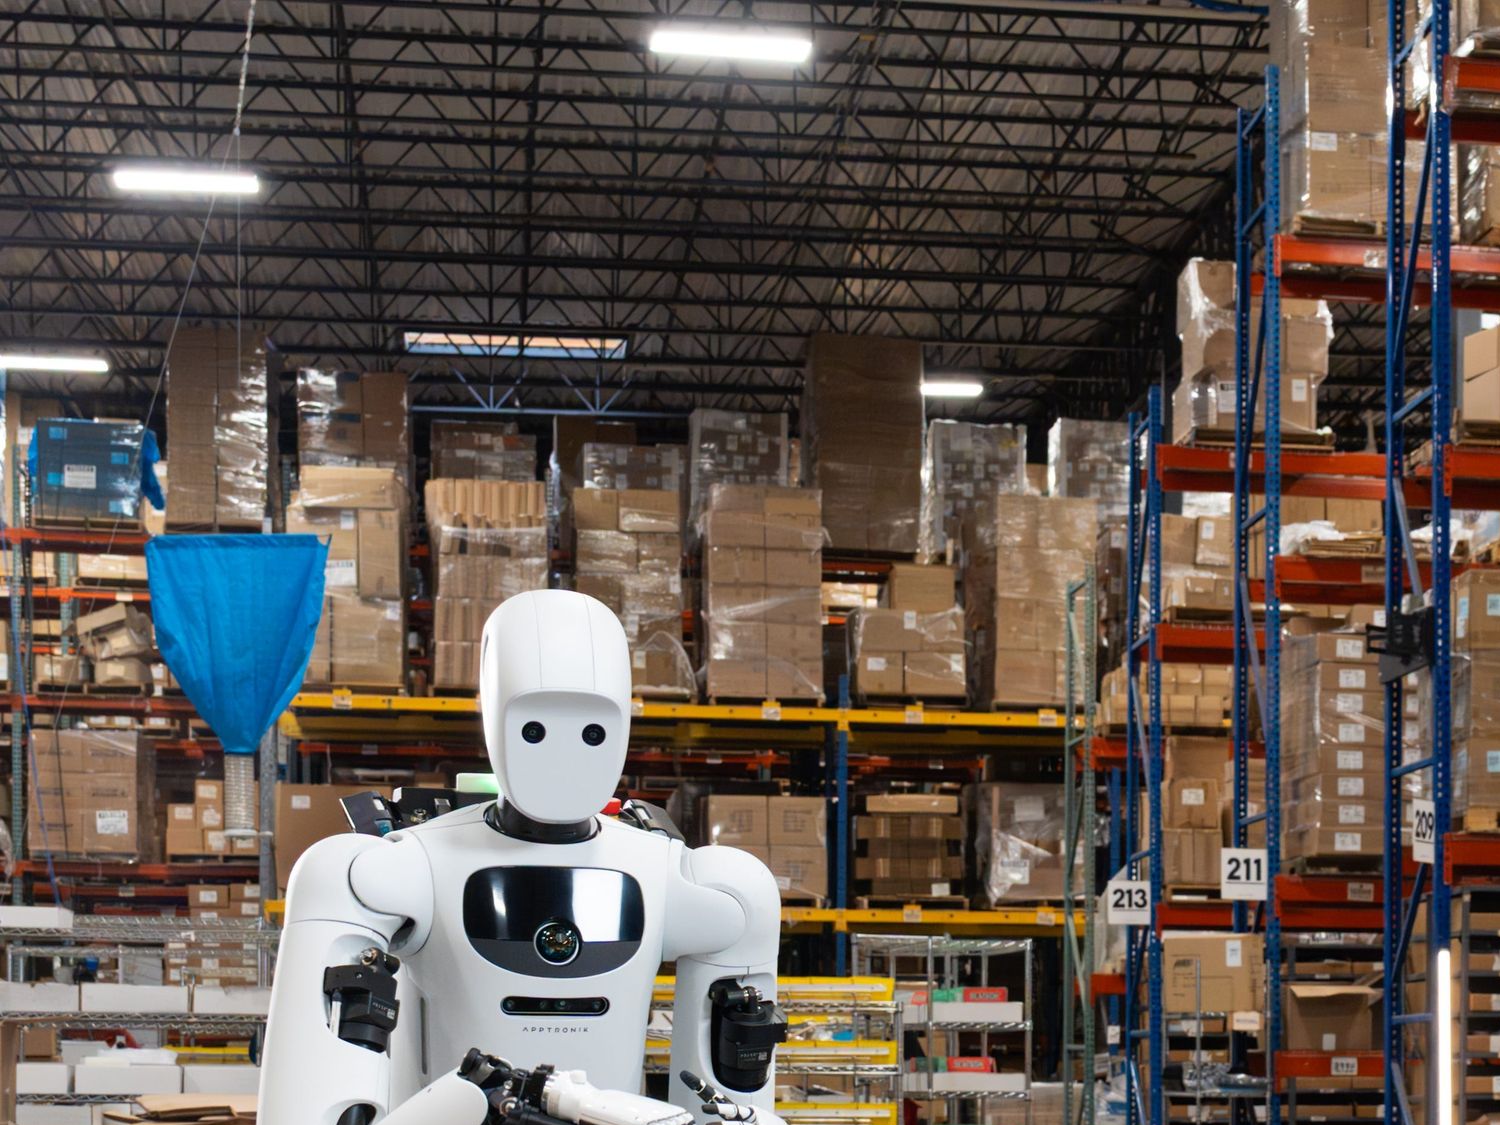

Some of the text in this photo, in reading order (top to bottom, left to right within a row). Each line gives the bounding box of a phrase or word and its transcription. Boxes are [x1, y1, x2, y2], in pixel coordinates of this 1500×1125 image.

[1415, 810, 1434, 840] 209
[1227, 857, 1261, 881] 211
[1113, 889, 1147, 908] 213
[522, 1026, 589, 1034] APPTRONIK
